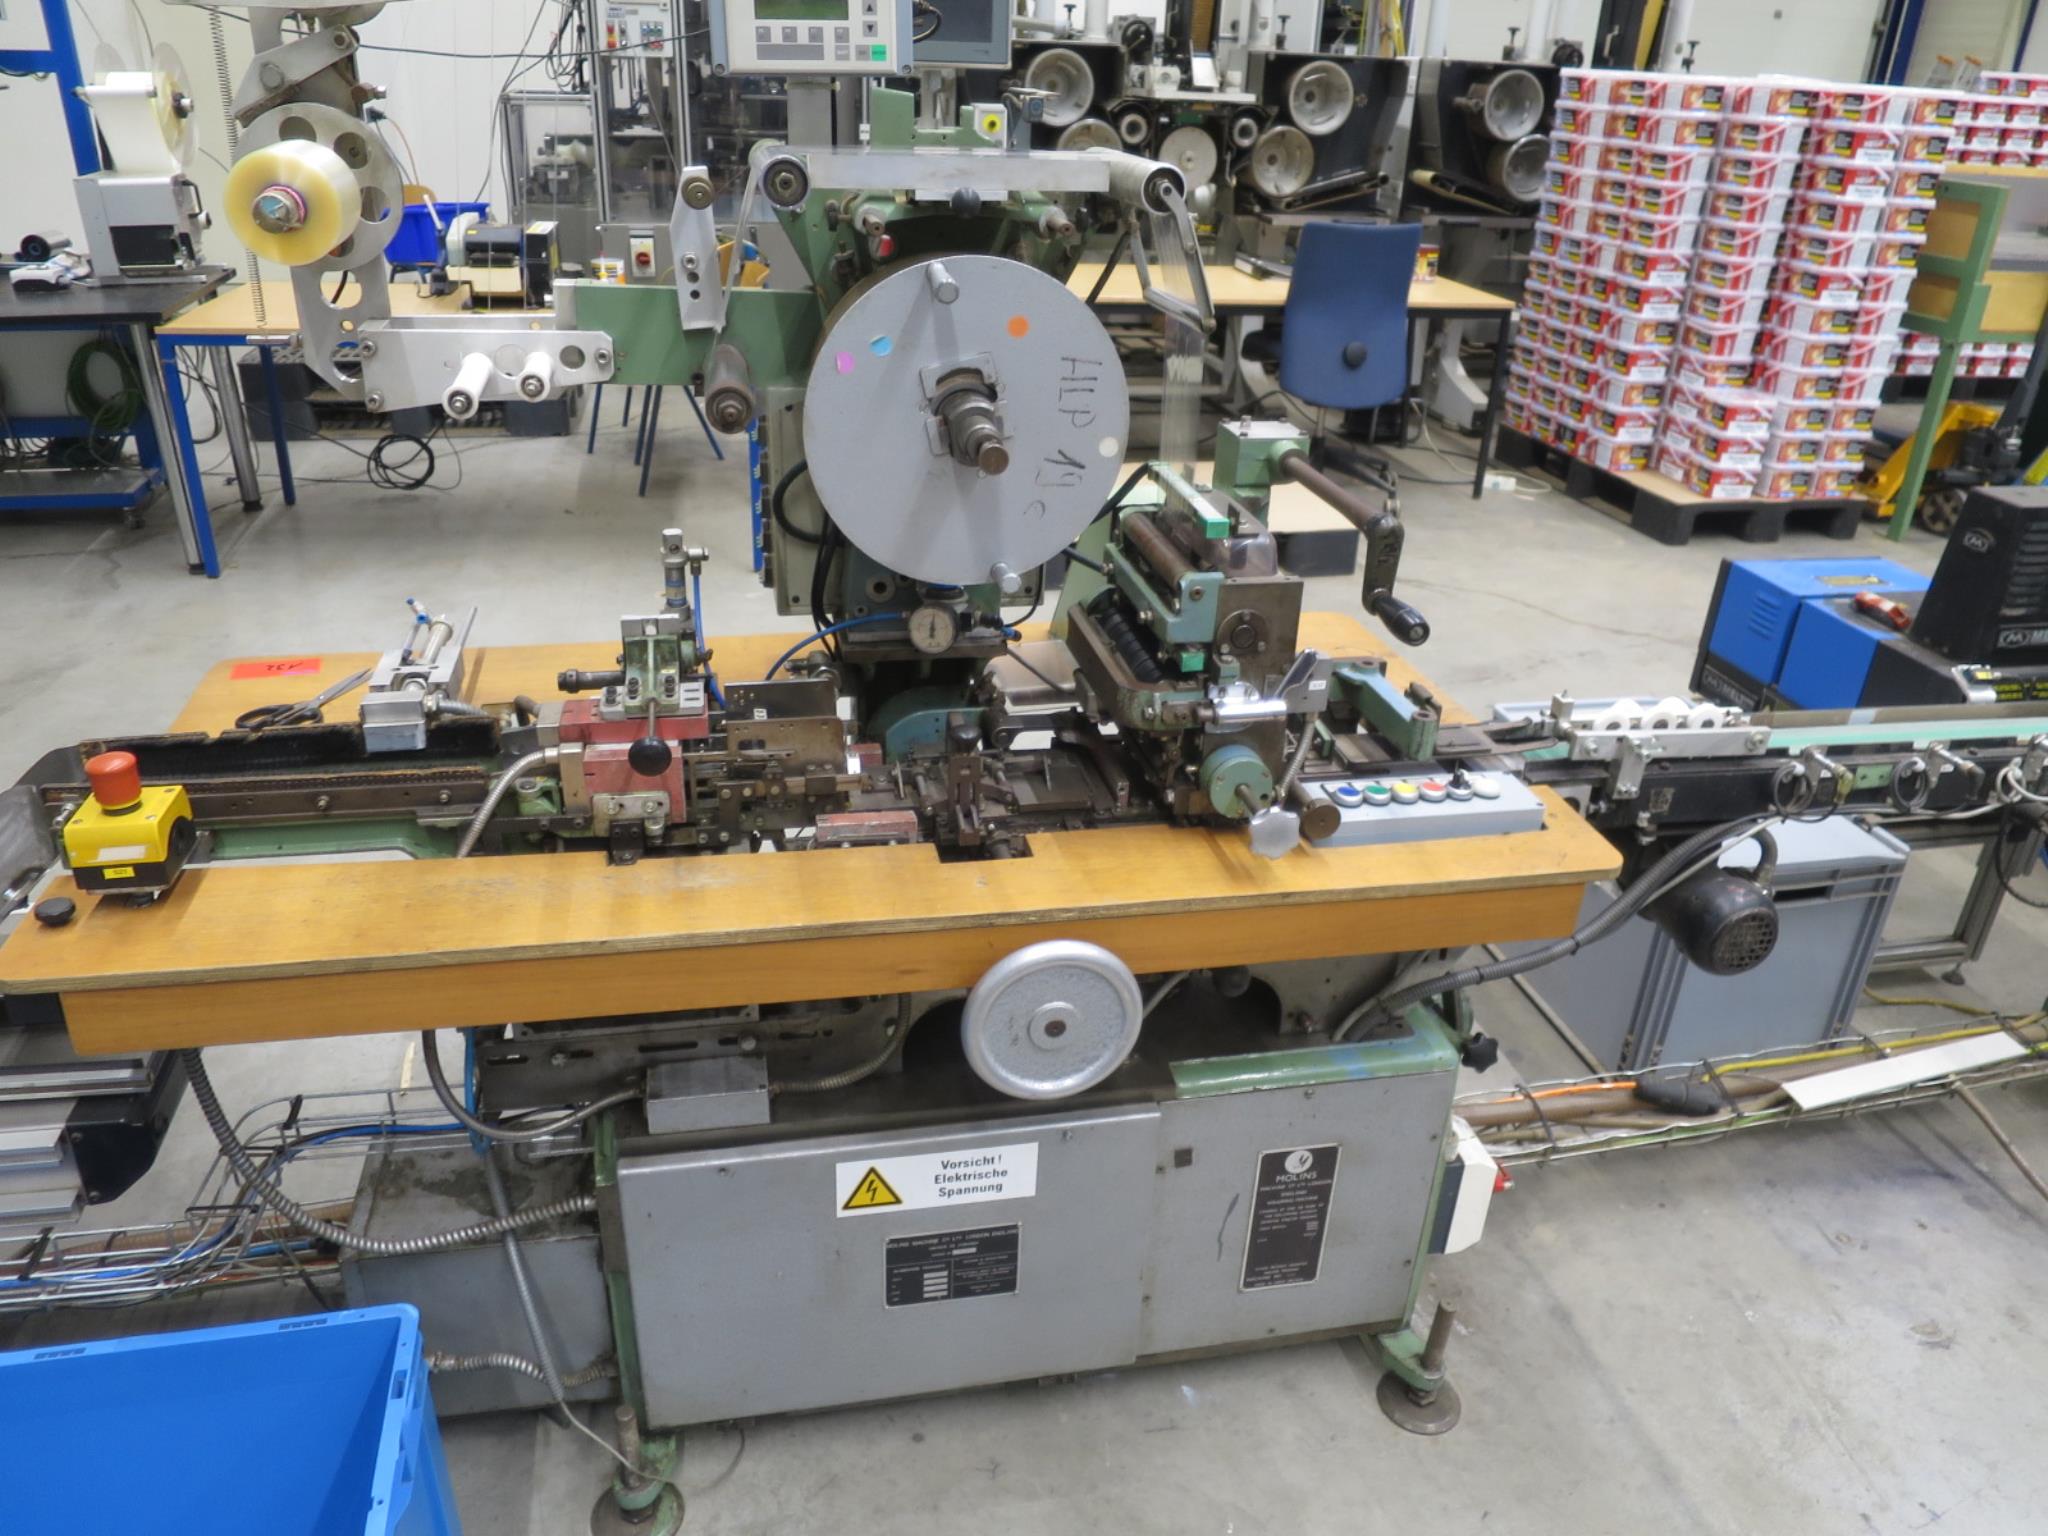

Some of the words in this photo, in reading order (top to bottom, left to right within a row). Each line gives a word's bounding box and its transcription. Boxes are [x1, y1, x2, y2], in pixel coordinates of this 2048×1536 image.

[934, 1168, 1008, 1185] Elektrische
[1275, 1170, 1318, 1183] MOLINS
[938, 1183, 1003, 1199] Spannung
